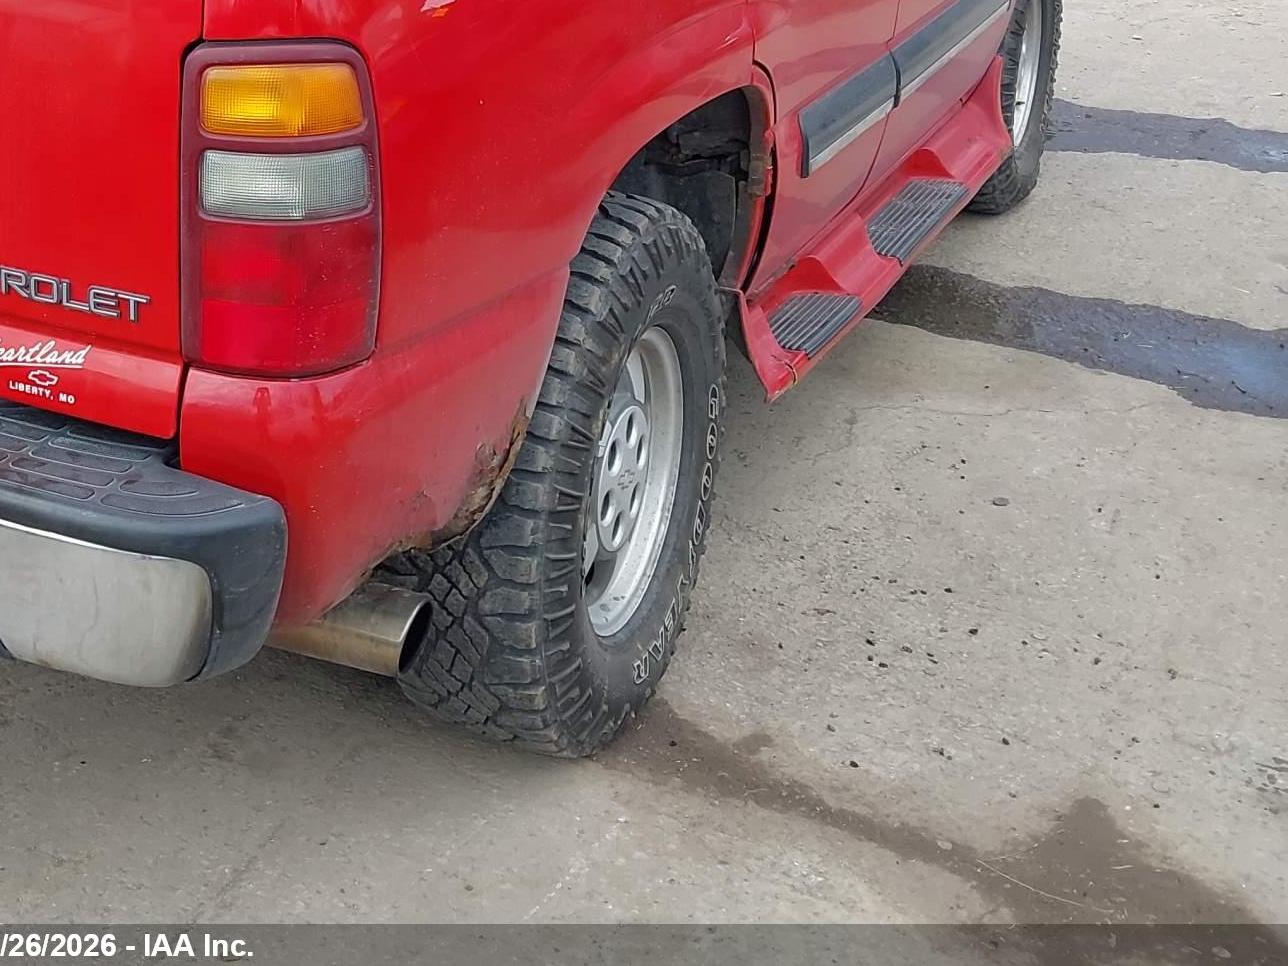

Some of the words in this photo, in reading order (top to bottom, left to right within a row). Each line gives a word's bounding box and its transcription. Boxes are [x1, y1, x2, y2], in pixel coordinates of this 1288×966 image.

[9, 380, 54, 400] LIBERTY,
[59, 393, 75, 404] MO
[632, 384, 720, 685] GOODYEAR
